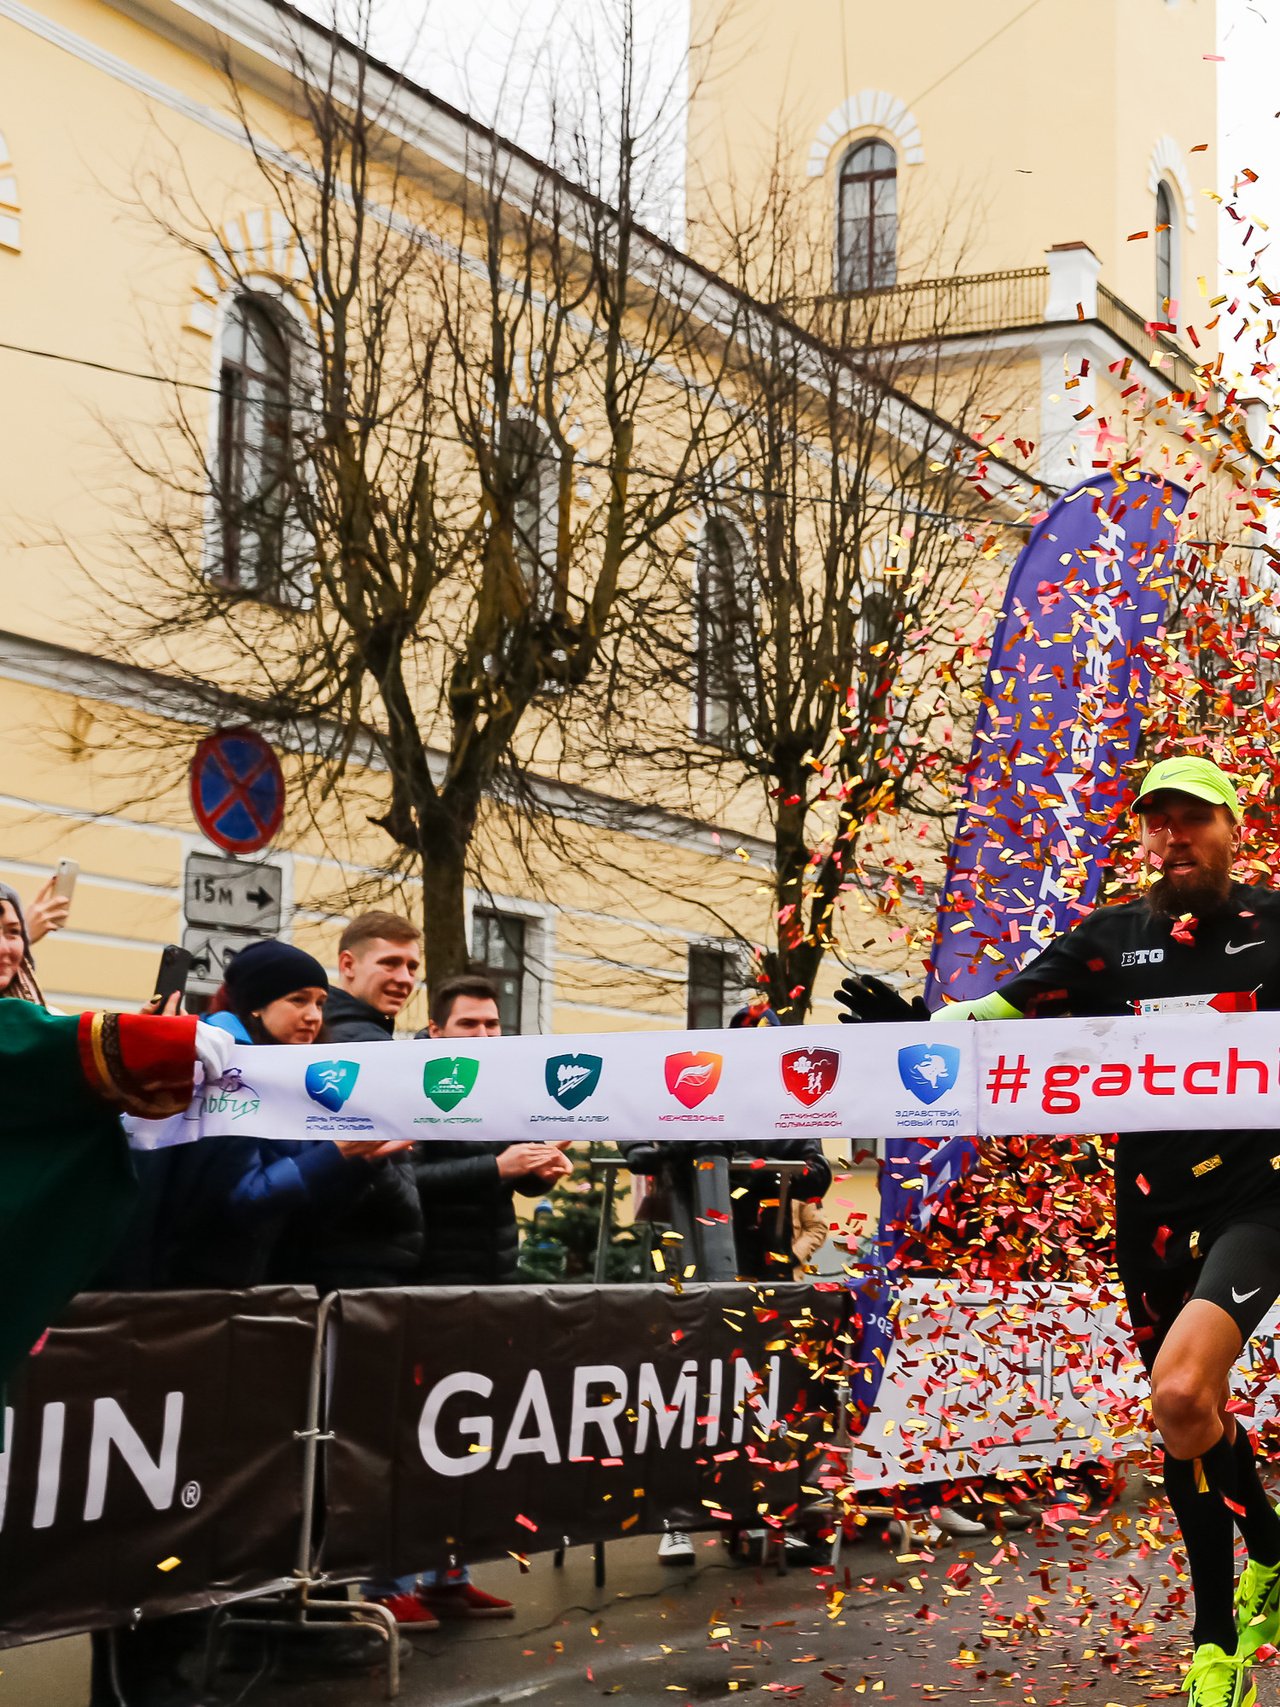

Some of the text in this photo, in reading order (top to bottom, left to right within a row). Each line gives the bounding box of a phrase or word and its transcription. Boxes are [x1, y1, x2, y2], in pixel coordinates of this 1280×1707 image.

[1121, 948, 1165, 967] BTG
[530, 1115, 575, 1123] ДЛИННЫЕ
[658, 1114, 725, 1122] МЕЖСЕЗОНЬЕ
[779, 1110, 838, 1120] ГАТЧИНСКИЙ
[774, 1120, 843, 1129] ПОЛУМАРАФОН
[897, 1118, 933, 1127] НОВЫЙ
[418, 1355, 781, 1477] GARMIN
